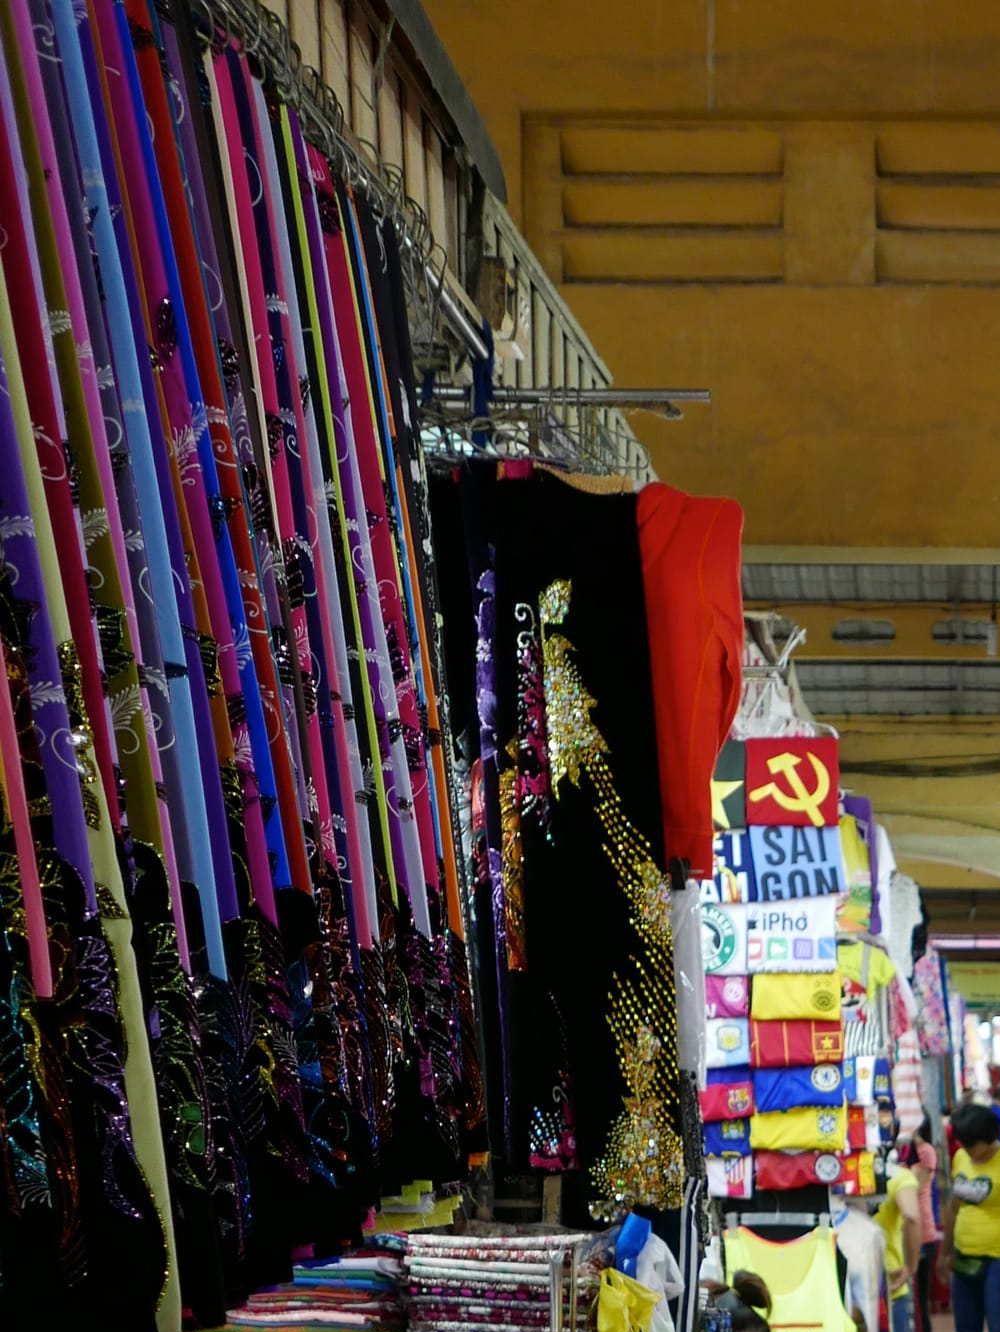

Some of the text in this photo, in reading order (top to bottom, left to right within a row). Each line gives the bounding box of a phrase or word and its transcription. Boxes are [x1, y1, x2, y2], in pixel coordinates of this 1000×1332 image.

[712, 830, 742, 867] ET
[762, 826, 828, 866] SAI
[699, 870, 749, 903] AM
[760, 866, 840, 903] GON
